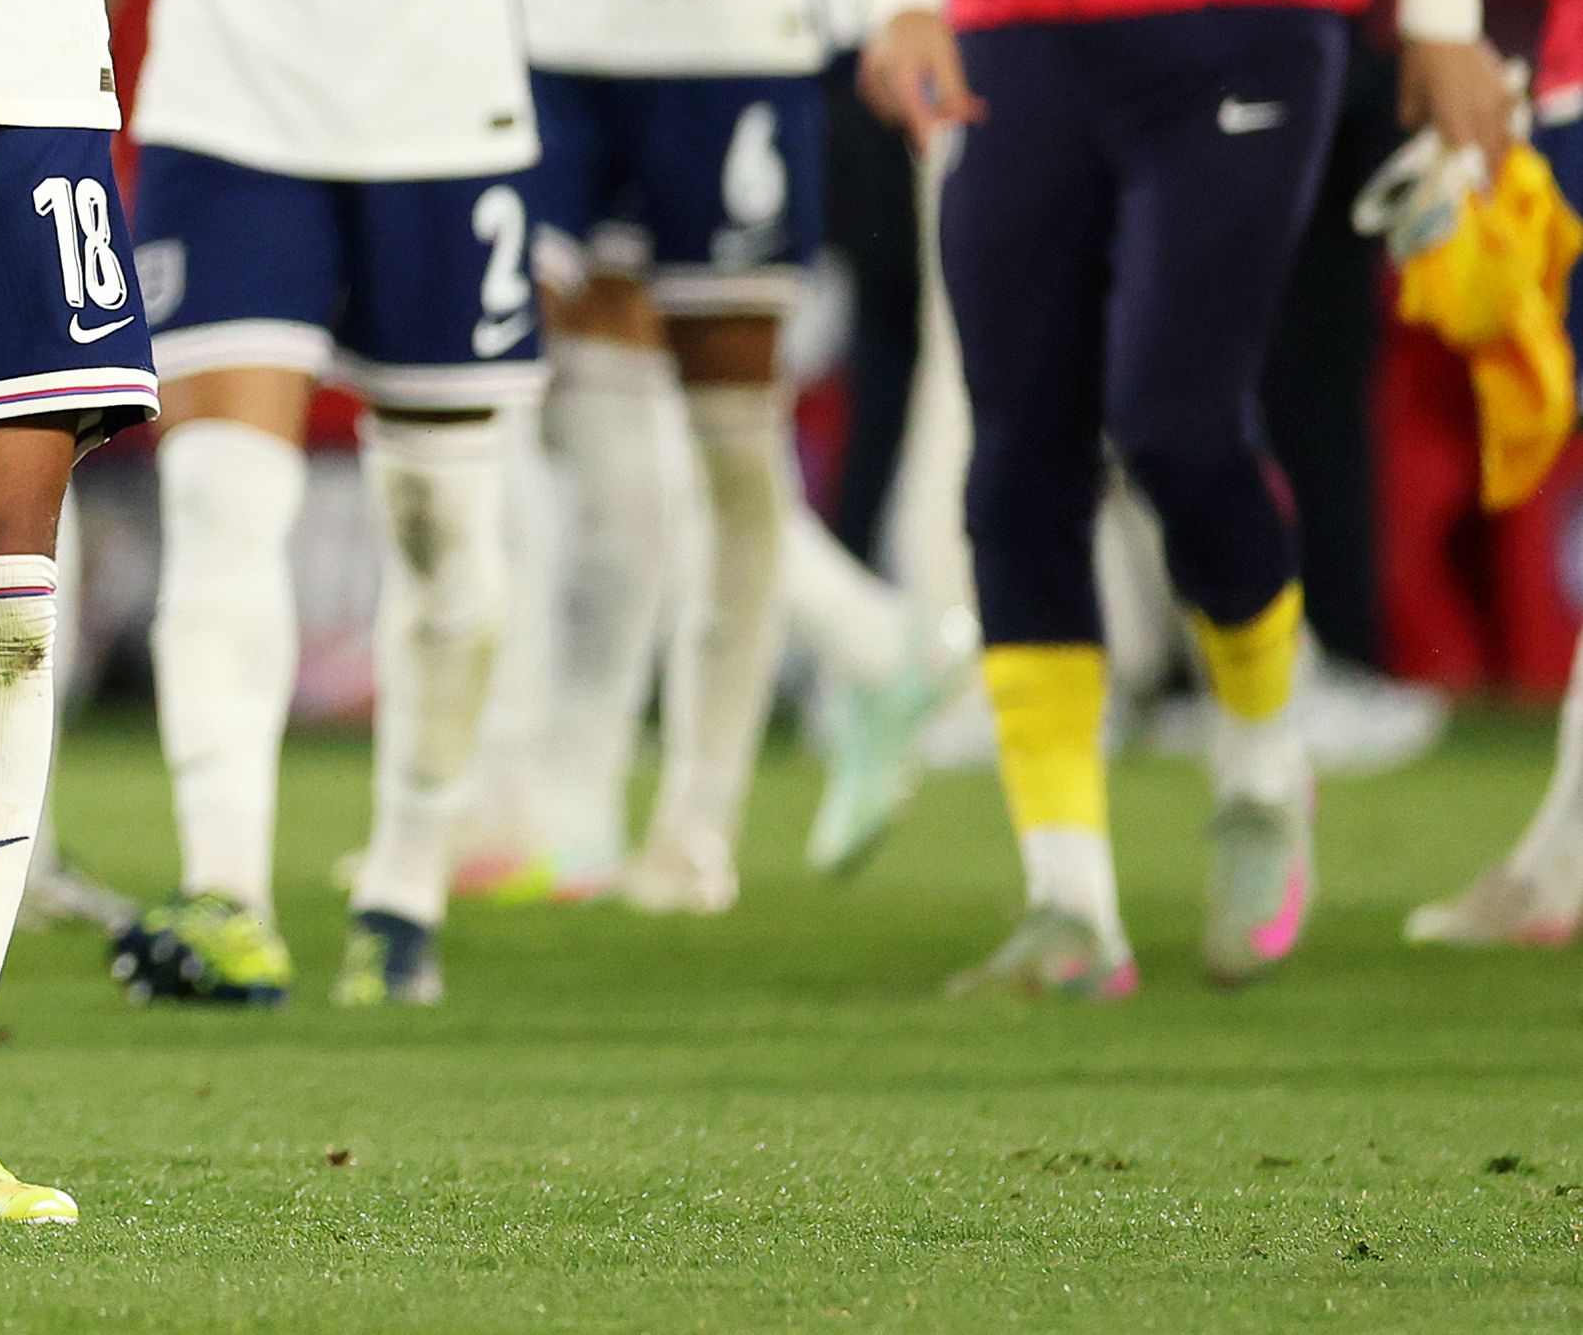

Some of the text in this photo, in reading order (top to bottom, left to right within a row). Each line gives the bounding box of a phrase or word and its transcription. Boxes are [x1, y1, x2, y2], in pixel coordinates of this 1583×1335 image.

[721, 101, 788, 224] 6
[32, 176, 128, 311] 18
[471, 184, 532, 314] 2
